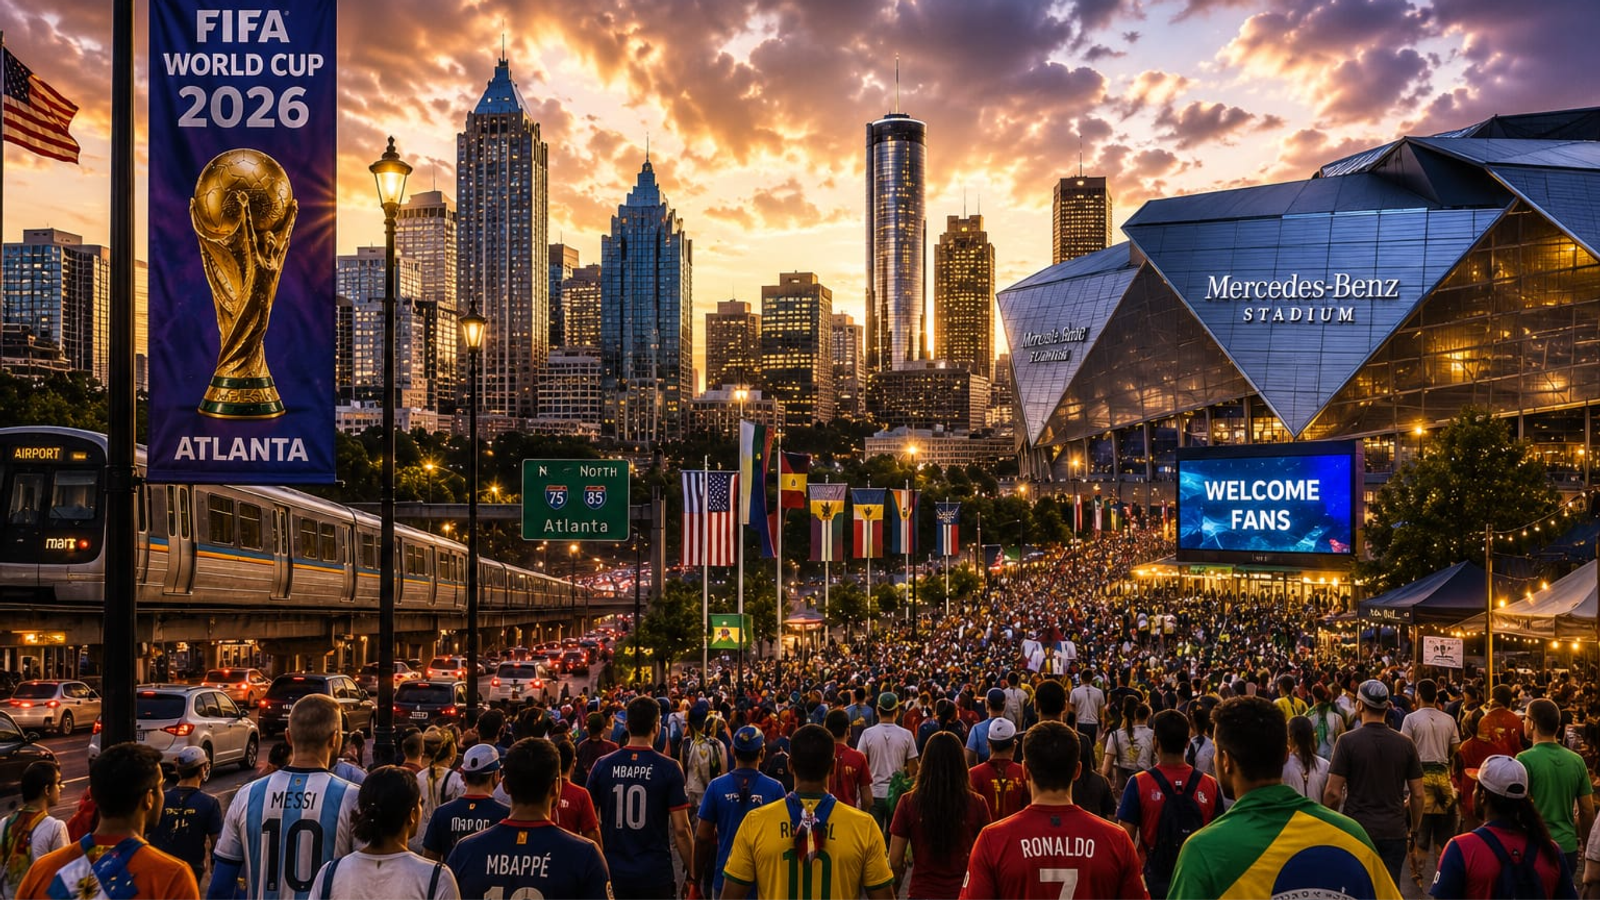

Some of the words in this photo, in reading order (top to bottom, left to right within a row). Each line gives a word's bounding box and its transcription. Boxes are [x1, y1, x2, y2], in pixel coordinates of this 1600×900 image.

[197, 10, 290, 43] FIFA
[163, 53, 263, 76] WORLD
[271, 53, 324, 76] CUP
[178, 85, 310, 128] 2026
[1205, 273, 1399, 299] Mercedes-Benz
[1243, 307, 1355, 322] STADIUM
[14, 447, 61, 459] AIRPORT
[174, 436, 309, 462] ATLANTA
[539, 465, 547, 477] N
[549, 491, 564, 505] 75
[587, 491, 603, 505] 85
[1204, 479, 1320, 501] WELCOME
[543, 518, 608, 533] Atlanta
[1231, 509, 1292, 531] FANS
[612, 764, 654, 781] MBAPPÉ
[270, 791, 317, 810] MESSI
[612, 783, 647, 830] 10
[261, 818, 324, 893] 10
[1020, 836, 1095, 859] RONALDO
[486, 852, 551, 878] MBAPPÉ
[783, 848, 832, 900] 10
